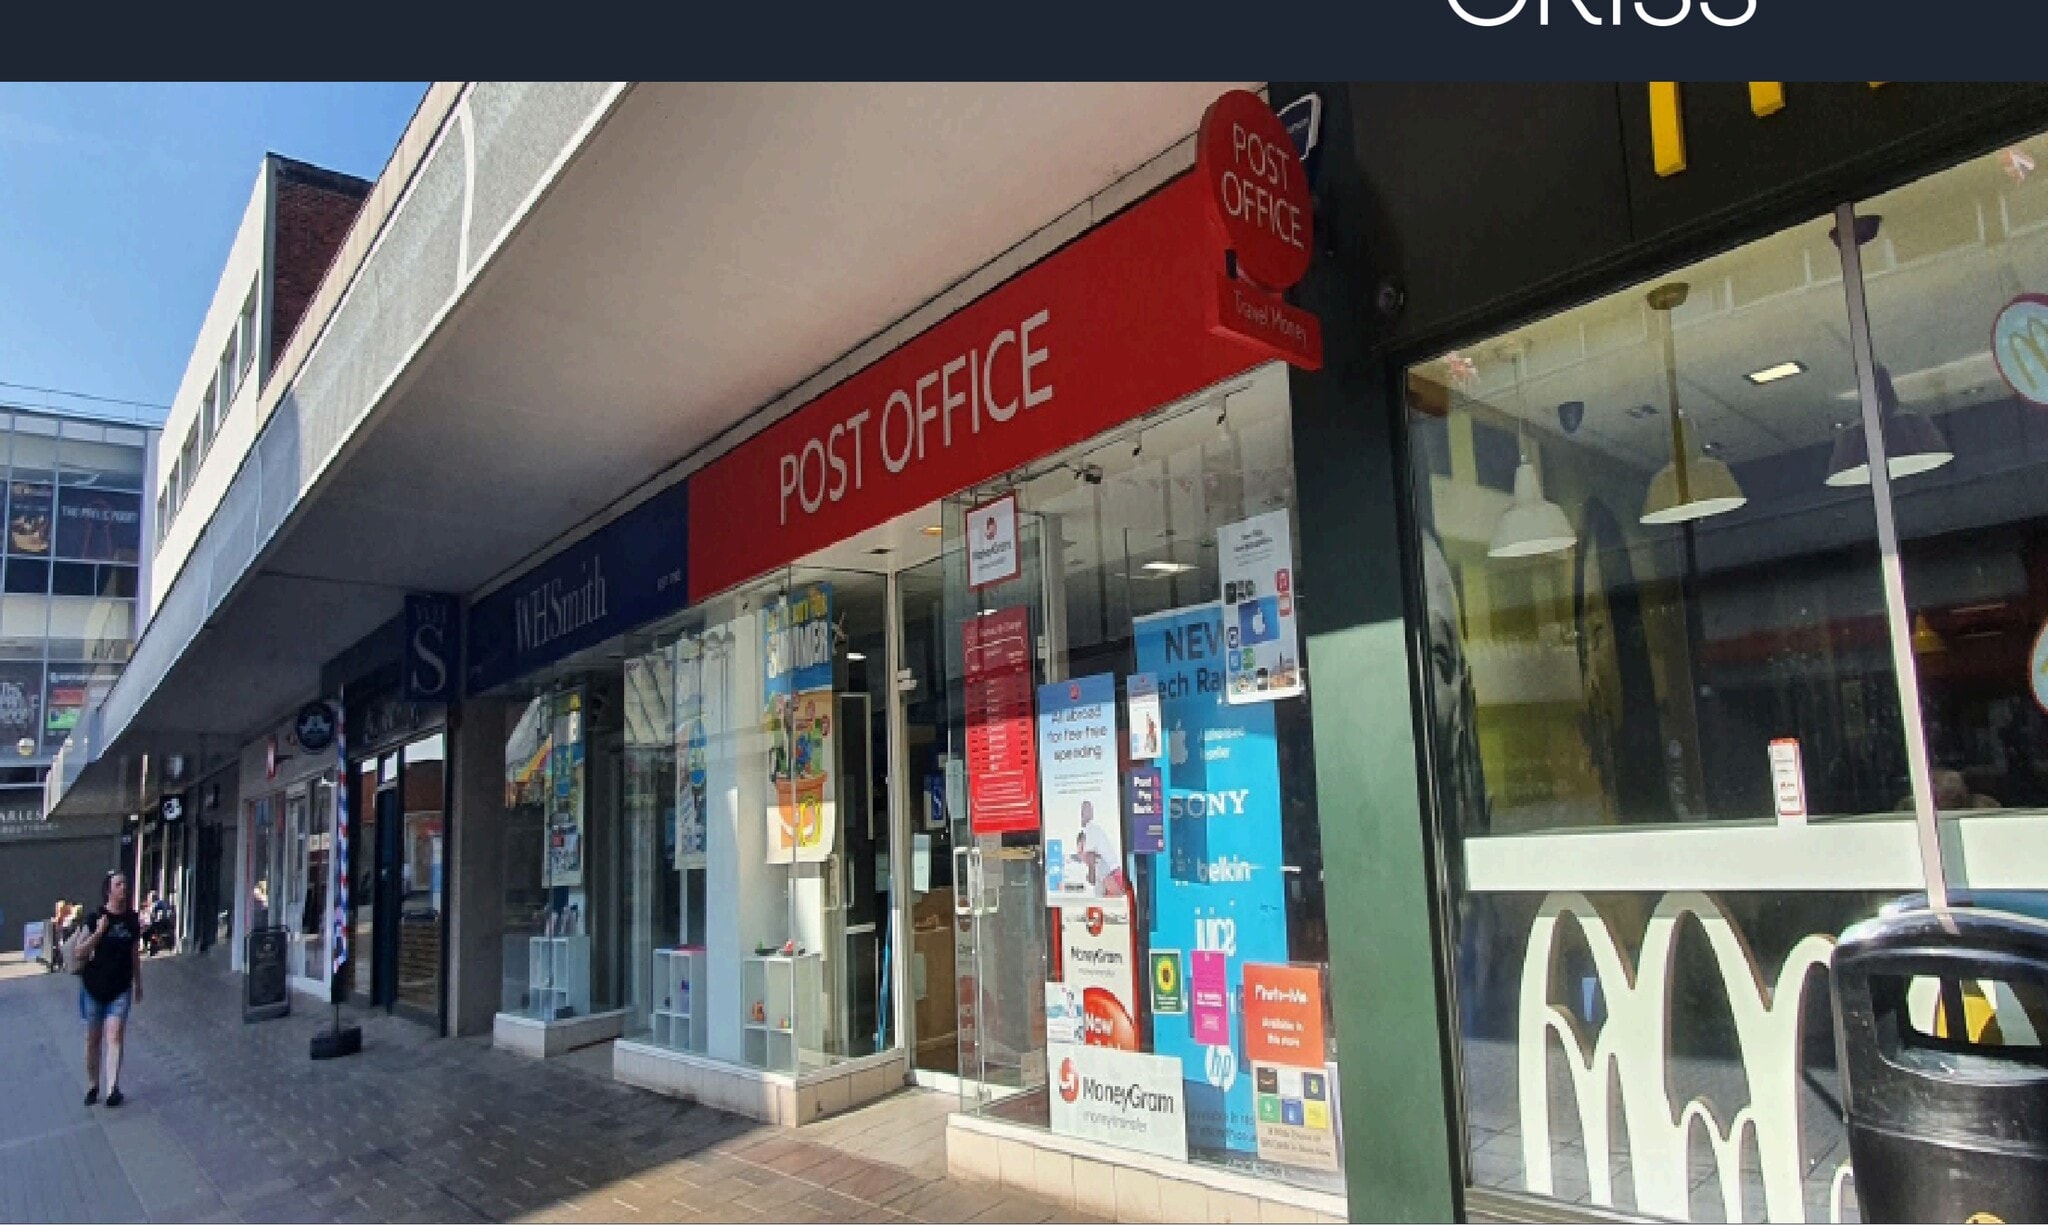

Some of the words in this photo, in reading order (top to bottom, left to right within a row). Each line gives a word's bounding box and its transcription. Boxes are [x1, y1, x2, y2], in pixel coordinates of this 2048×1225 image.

[1232, 122, 1291, 191] POST
[1221, 171, 1305, 250] OFFICE
[1232, 290, 1270, 326] Travel
[1270, 308, 1308, 350] Money
[780, 453, 871, 526] POST
[880, 309, 1054, 474] OFFICE
[515, 554, 608, 653] WHSmith
[412, 624, 446, 693] S
[1158, 671, 1189, 700] ech
[1168, 788, 1250, 820] SONY
[1197, 854, 1252, 883] belkin
[1070, 945, 1123, 965] MoneyGram
[1083, 1076, 1174, 1114] MoneyGram
